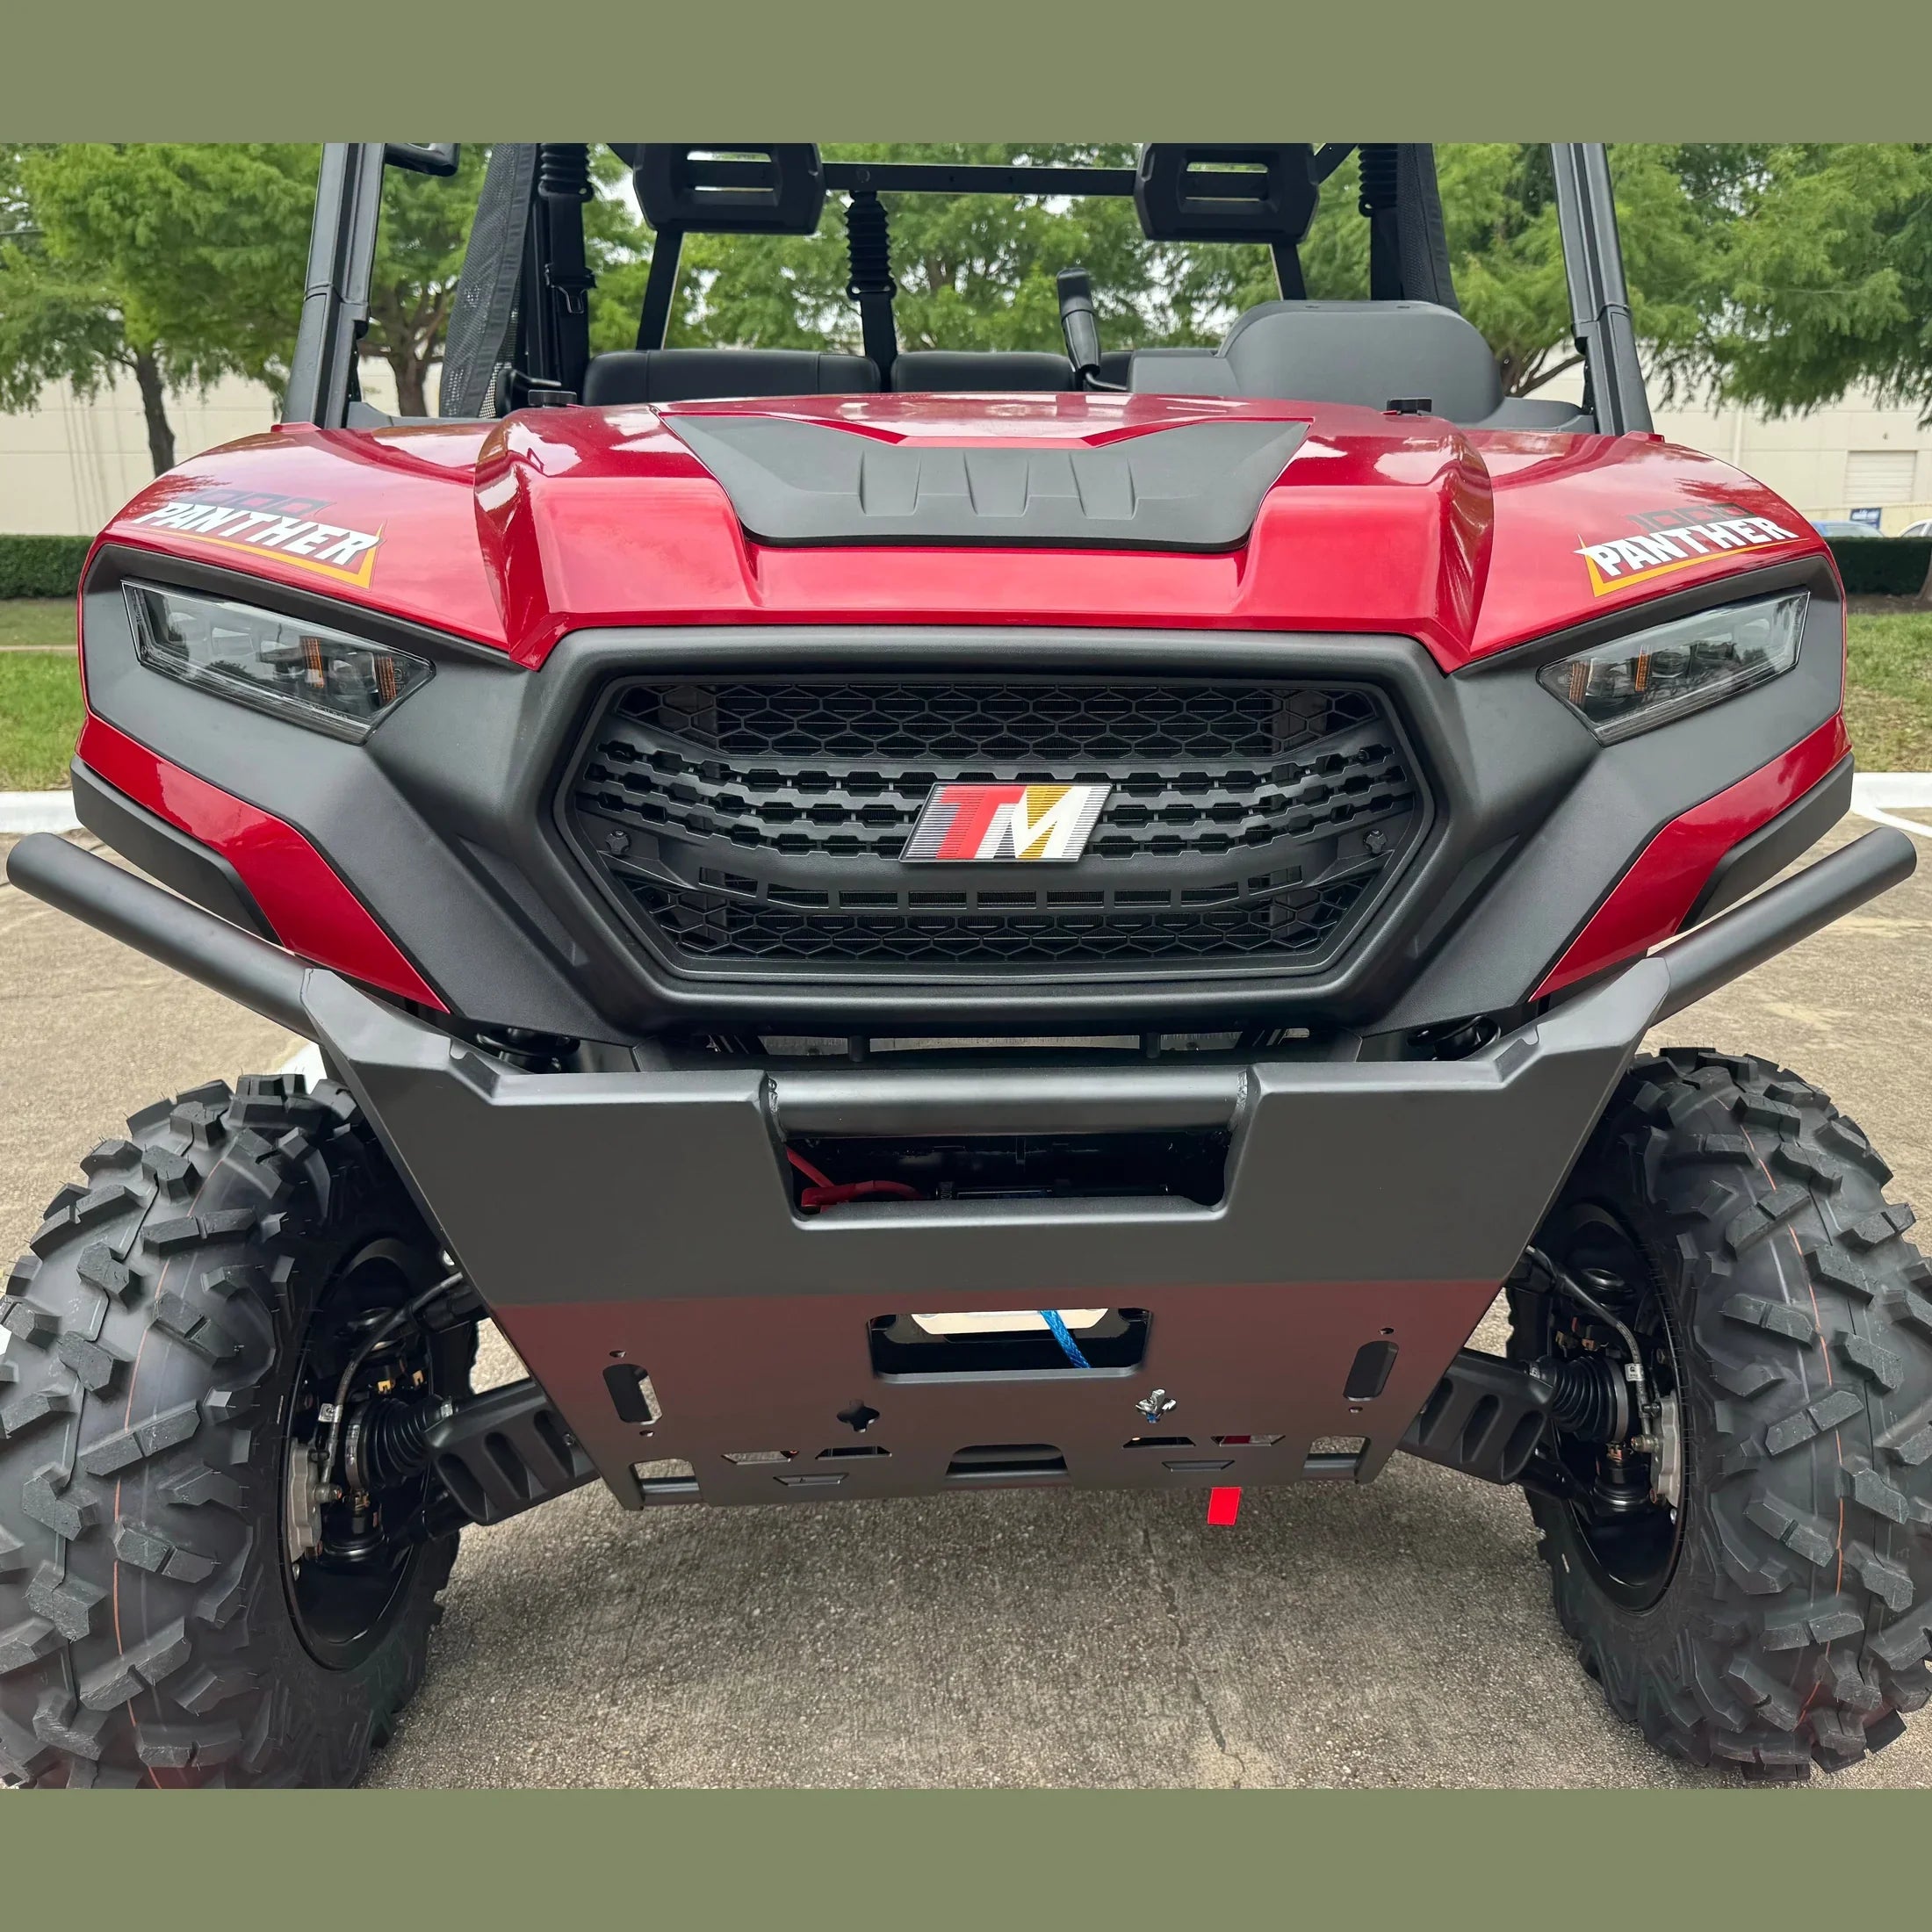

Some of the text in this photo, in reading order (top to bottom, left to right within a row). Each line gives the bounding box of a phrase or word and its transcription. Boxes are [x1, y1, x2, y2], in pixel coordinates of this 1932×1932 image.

[133, 501, 380, 566] PANTHER
[1574, 516, 1799, 576] PANTHER
[935, 785, 1092, 859] TM
